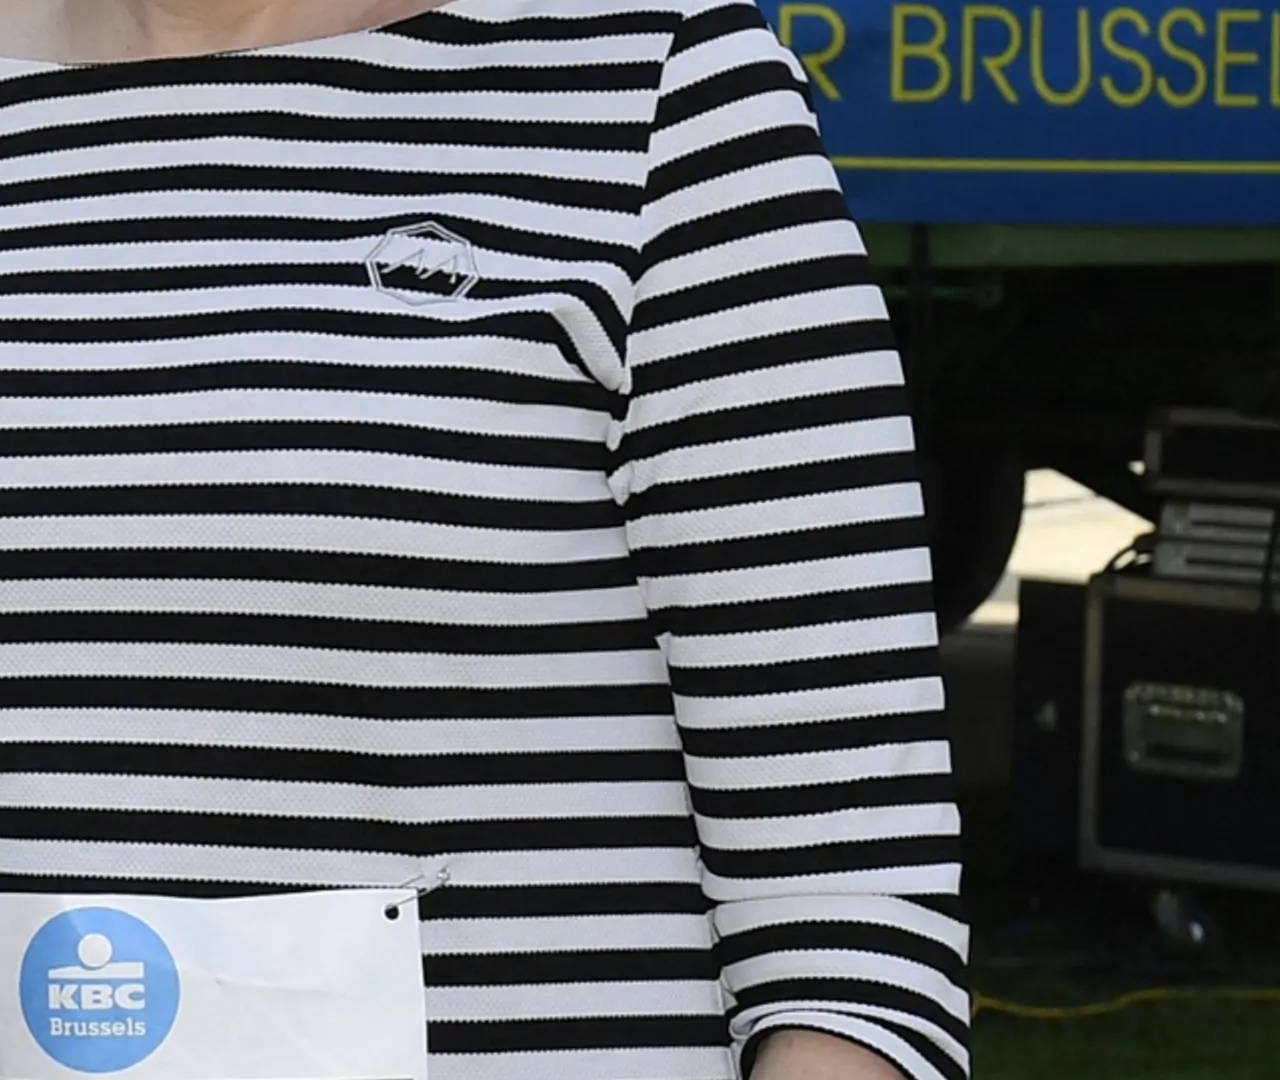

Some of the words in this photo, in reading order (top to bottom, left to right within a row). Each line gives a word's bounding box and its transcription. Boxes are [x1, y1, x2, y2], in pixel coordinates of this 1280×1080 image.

[890, 2, 1280, 109] BRUSSE
[48, 983, 146, 1011] KBC
[49, 1016, 146, 1037] Brussels
